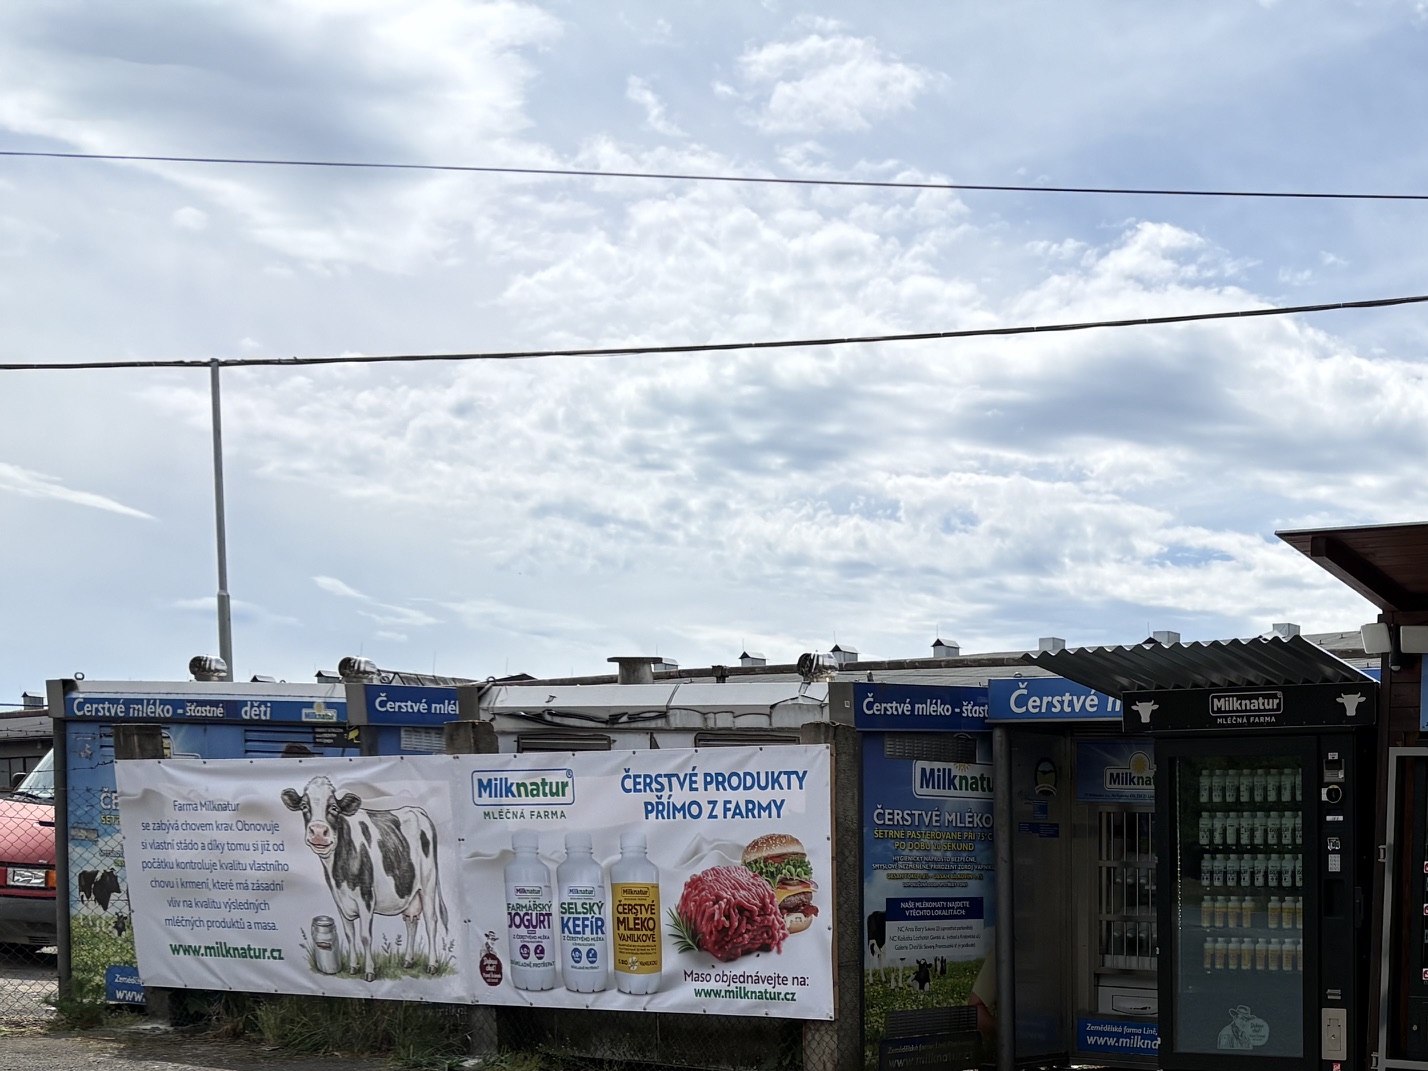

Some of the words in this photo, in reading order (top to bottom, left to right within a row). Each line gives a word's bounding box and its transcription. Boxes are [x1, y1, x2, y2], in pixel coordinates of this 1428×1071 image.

[375, 692, 428, 713] Čerstvé
[862, 692, 912, 716] Čerstvé
[914, 698, 952, 717] mléko
[1009, 681, 1099, 714] Čerstvé
[1213, 694, 1279, 712] Milknatur
[73, 698, 125, 717] Čerstvé
[129, 699, 173, 718] mléko
[186, 702, 224, 718] šťastné
[241, 701, 271, 720] děti
[1216, 714, 1247, 725] MLÉČNÁ
[1250, 715, 1276, 724] FARMA
[620, 766, 699, 794] ČERSTVÉ
[703, 770, 808, 792] PRODUKTY
[173, 800, 199, 812] Farma
[199, 800, 240, 812] Milknatur
[483, 808, 526, 820] MLÉČNÁ
[530, 810, 567, 820] FARMA
[643, 794, 703, 820] PŘÍMO
[707, 800, 718, 820] Z
[722, 798, 786, 819] FARMY
[873, 804, 941, 827] ČERSTVÉ
[944, 808, 994, 828] MLÉKO
[141, 822, 151, 831] se
[152, 820, 180, 834] zabývá
[181, 820, 214, 831] chovem
[215, 820, 235, 831] krav.
[236, 820, 280, 834] Obnovuje
[141, 840, 148, 850] si
[149, 839, 175, 850] vlastní
[176, 839, 199, 851] stádo
[200, 842, 206, 851] a
[207, 839, 226, 854] díky
[226, 841, 250, 852] tomu
[252, 840, 259, 852] si
[260, 840, 271, 854] již
[272, 840, 285, 852] od
[894, 841, 906, 850] PO
[908, 841, 931, 851] DOBU
[943, 841, 975, 851] SEKUND
[142, 858, 174, 871] počátku
[175, 859, 218, 873] kontroluje
[219, 859, 247, 871] kvalitu
[248, 860, 289, 872] vlastního
[150, 878, 174, 889] chovu
[175, 878, 179, 889] i
[180, 878, 211, 891] krmení,
[212, 879, 234, 890] které
[235, 880, 249, 891] má
[251, 880, 284, 892] zásadní
[167, 896, 181, 908] vliv
[183, 899, 193, 909] na
[194, 898, 222, 909] kvalitu
[222, 899, 270, 914] výsledných
[507, 900, 552, 912] FARMÁŘSKÝ
[560, 900, 605, 915] SELSKÝ
[616, 899, 656, 915] ČERSTVÉ
[164, 916, 205, 931] mléčných
[207, 917, 245, 931] produktů
[246, 922, 252, 930] a
[253, 921, 279, 931] masa.
[507, 912, 552, 930] JOGURT
[616, 914, 656, 932] MLÉKO
[617, 930, 656, 943] VANILKOVÉ
[169, 942, 285, 961] www.milknatur.cz
[683, 969, 712, 983] Maso
[714, 970, 789, 989] objednávejte
[791, 976, 810, 987] na:
[693, 986, 797, 1002] www.milknatur.cz
[1123, 1024, 1142, 1034] farma
